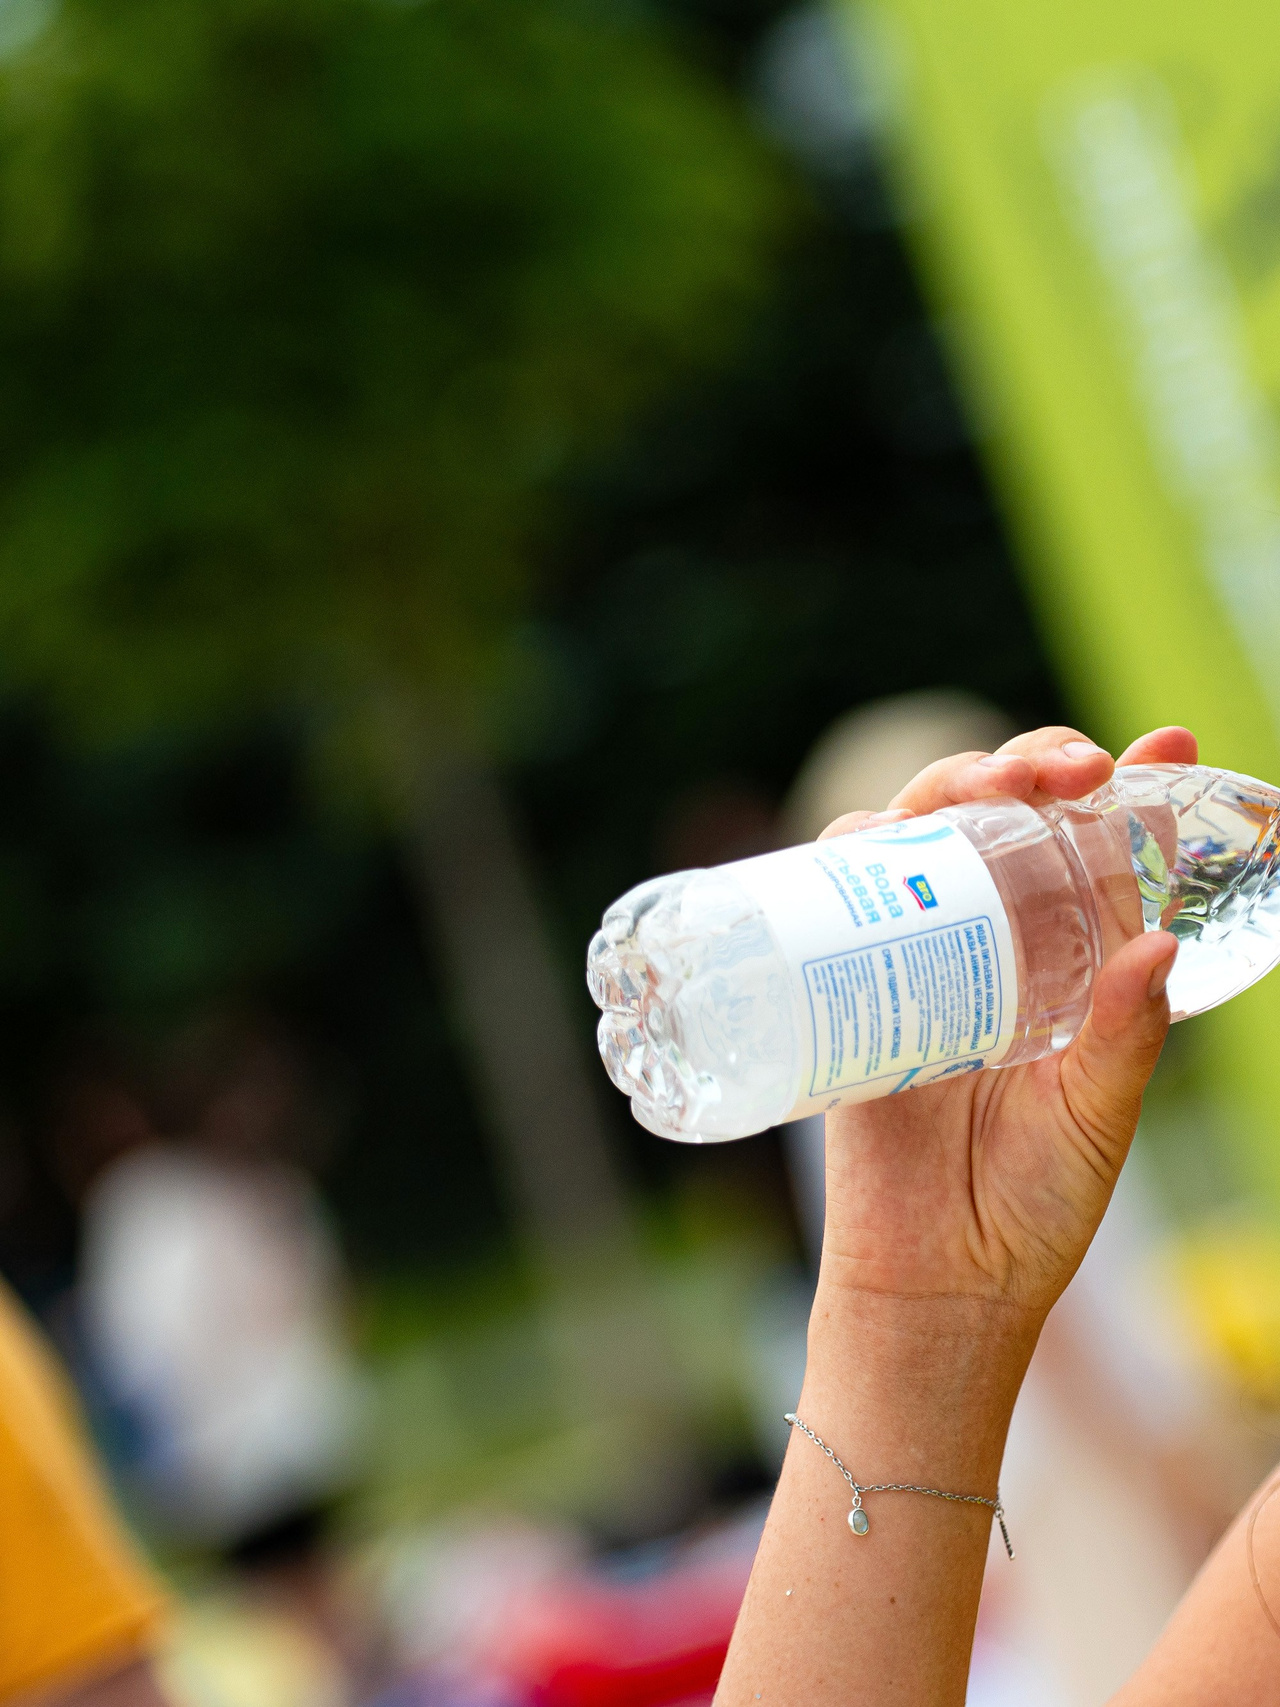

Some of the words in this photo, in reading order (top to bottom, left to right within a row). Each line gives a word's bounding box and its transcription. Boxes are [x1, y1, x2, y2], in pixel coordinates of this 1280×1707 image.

[865, 862, 904, 918] Вода
[916, 881, 932, 902] aro
[963, 926, 977, 953] (АКВА
[975, 924, 988, 947] ВОДА
[882, 948, 894, 971] СРОК
[981, 948, 994, 990] ПИТЬЕВАЯ
[887, 971, 900, 1014] ГОДНОСТИ
[892, 1016, 901, 1025] 12
